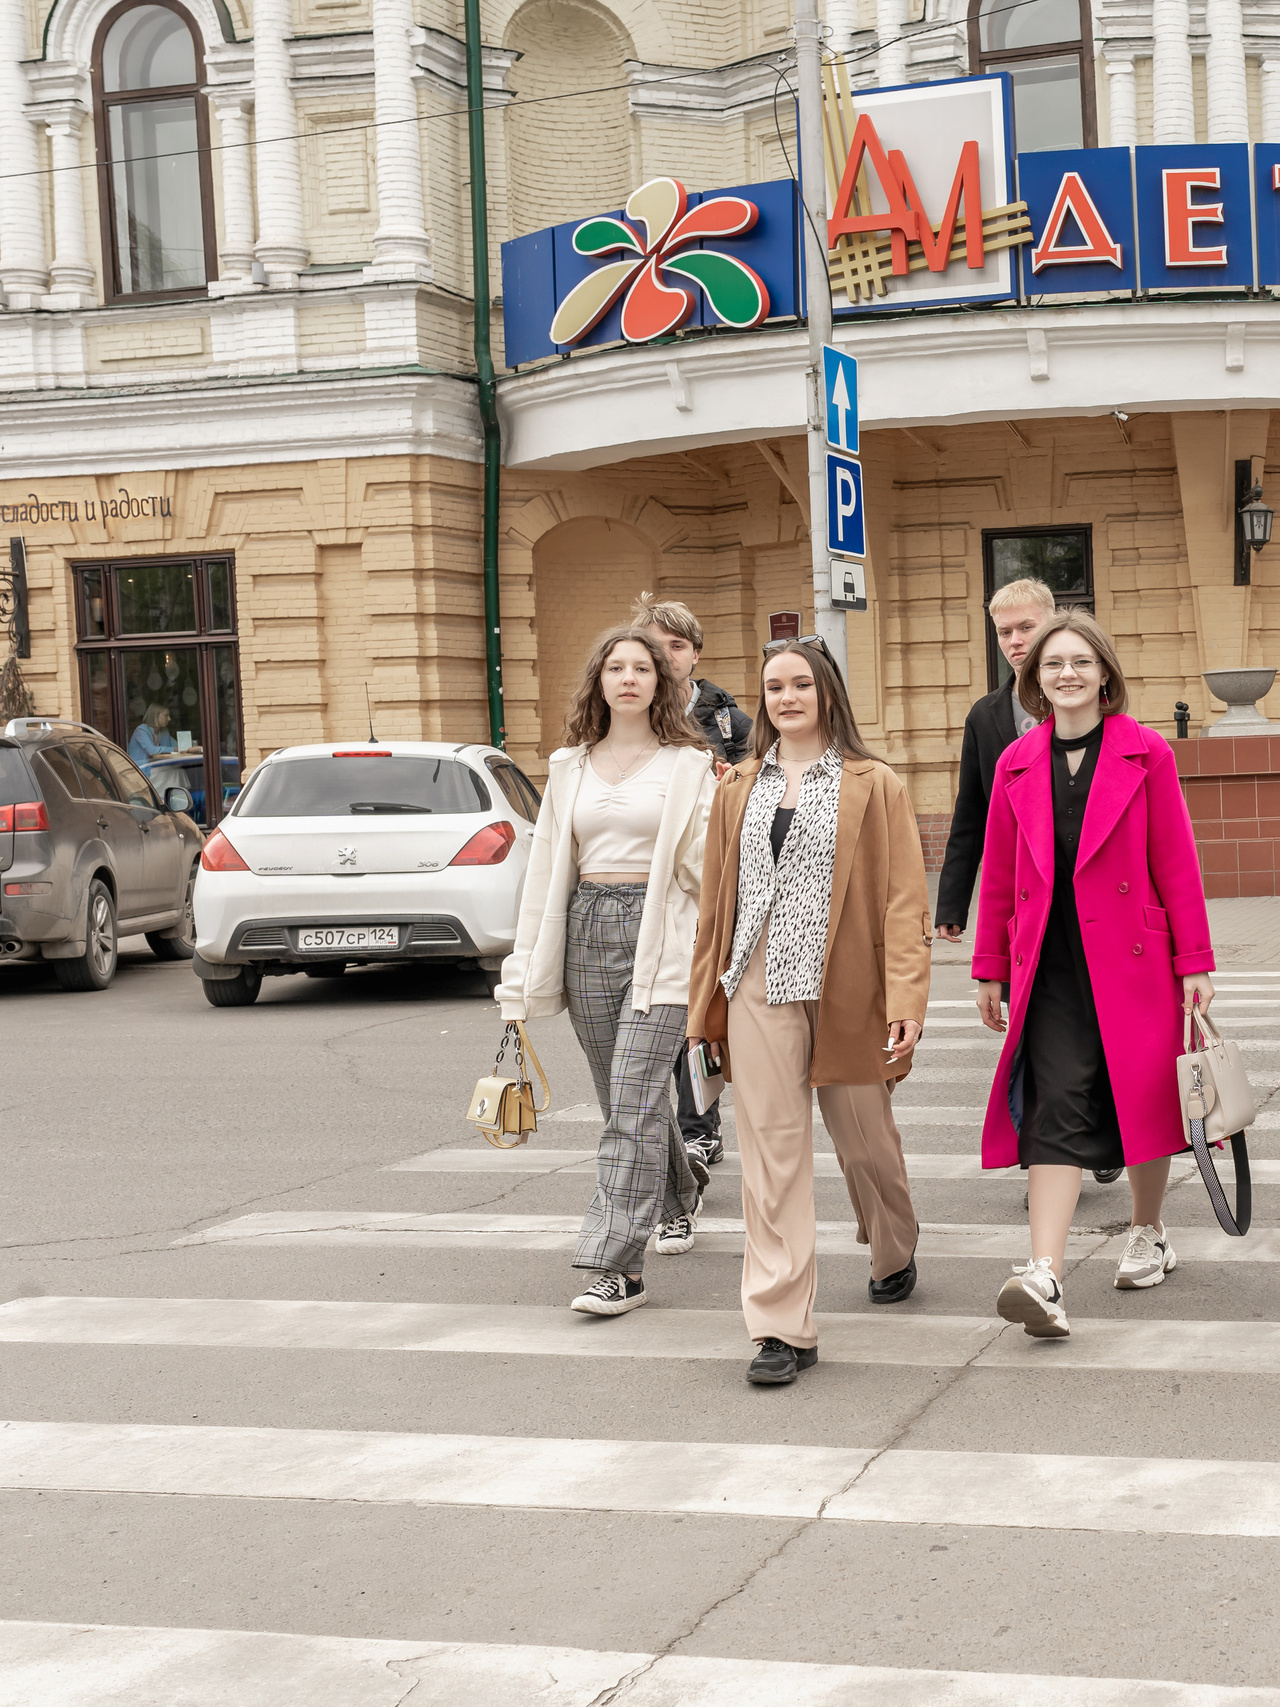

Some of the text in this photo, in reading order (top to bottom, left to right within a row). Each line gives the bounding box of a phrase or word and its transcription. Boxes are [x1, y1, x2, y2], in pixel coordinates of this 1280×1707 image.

[1, 488, 172, 530] сладости и радости
[370, 928, 394, 940] 124
